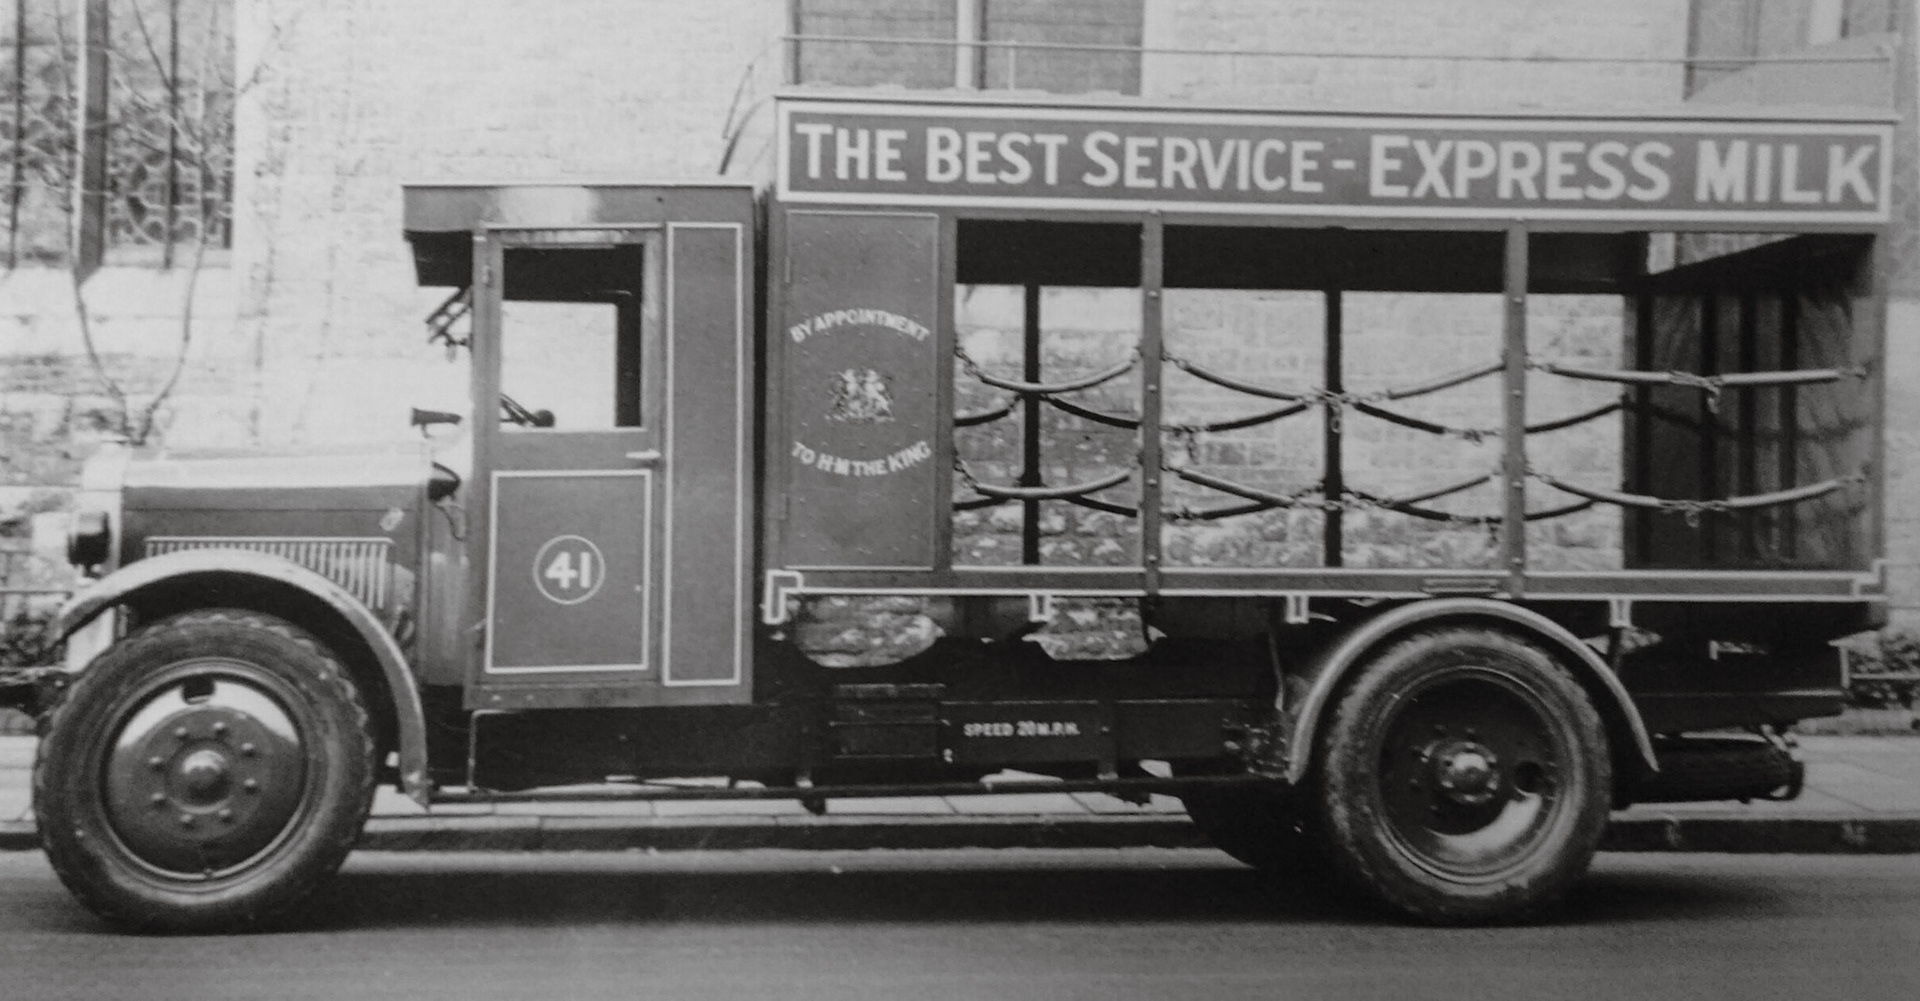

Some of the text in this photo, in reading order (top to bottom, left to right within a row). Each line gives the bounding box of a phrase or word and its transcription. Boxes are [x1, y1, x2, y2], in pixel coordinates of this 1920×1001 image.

[796, 123, 907, 181] THE
[926, 127, 1068, 185] BEST
[1083, 131, 1324, 192] SERVICE
[1369, 134, 1675, 201] EXPRESS
[1695, 138, 1877, 203] MILK
[790, 308, 930, 343] BY APPOINTMENT
[791, 441, 815, 464] TO
[851, 459, 887, 477] THE
[887, 440, 931, 472] KING
[545, 551, 591, 589] 41
[963, 722, 1014, 737] SPEED
